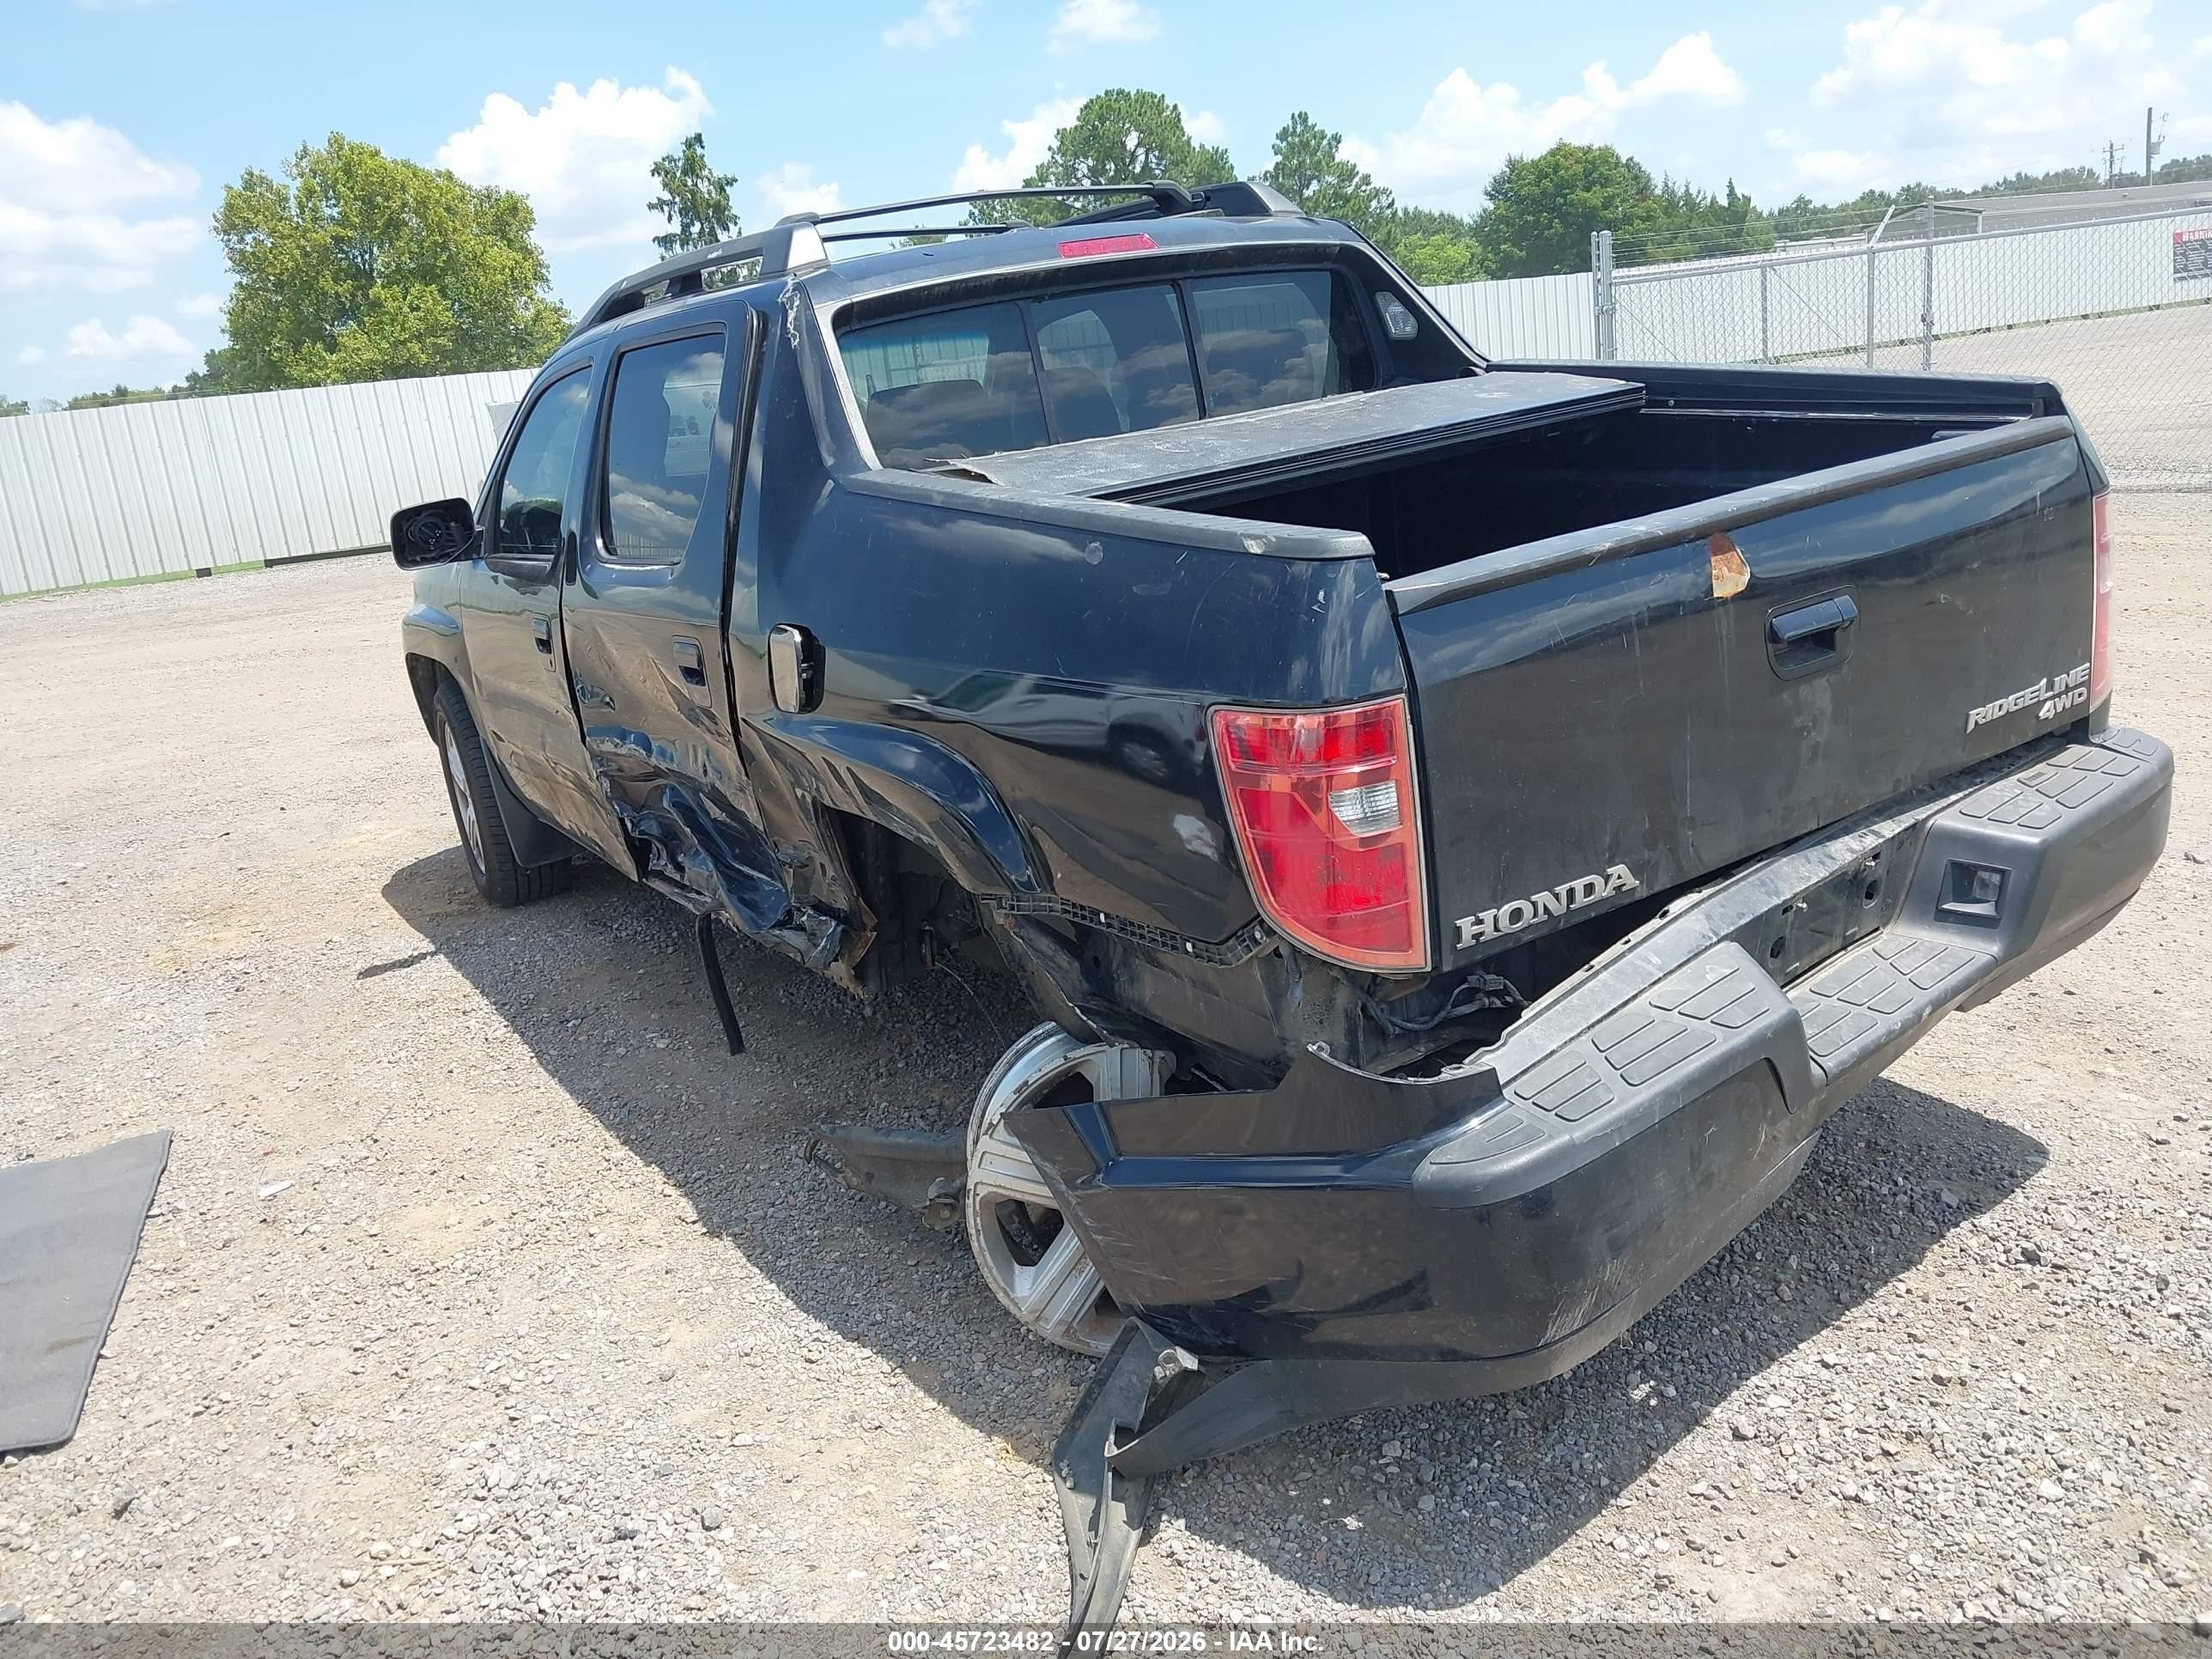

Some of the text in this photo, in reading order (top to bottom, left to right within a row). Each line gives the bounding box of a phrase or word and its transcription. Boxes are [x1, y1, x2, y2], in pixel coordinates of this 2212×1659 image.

[1966, 662, 2090, 735] RIDGELINE
[2038, 687, 2087, 720] 4WD
[1455, 864, 1639, 951] HONDA
